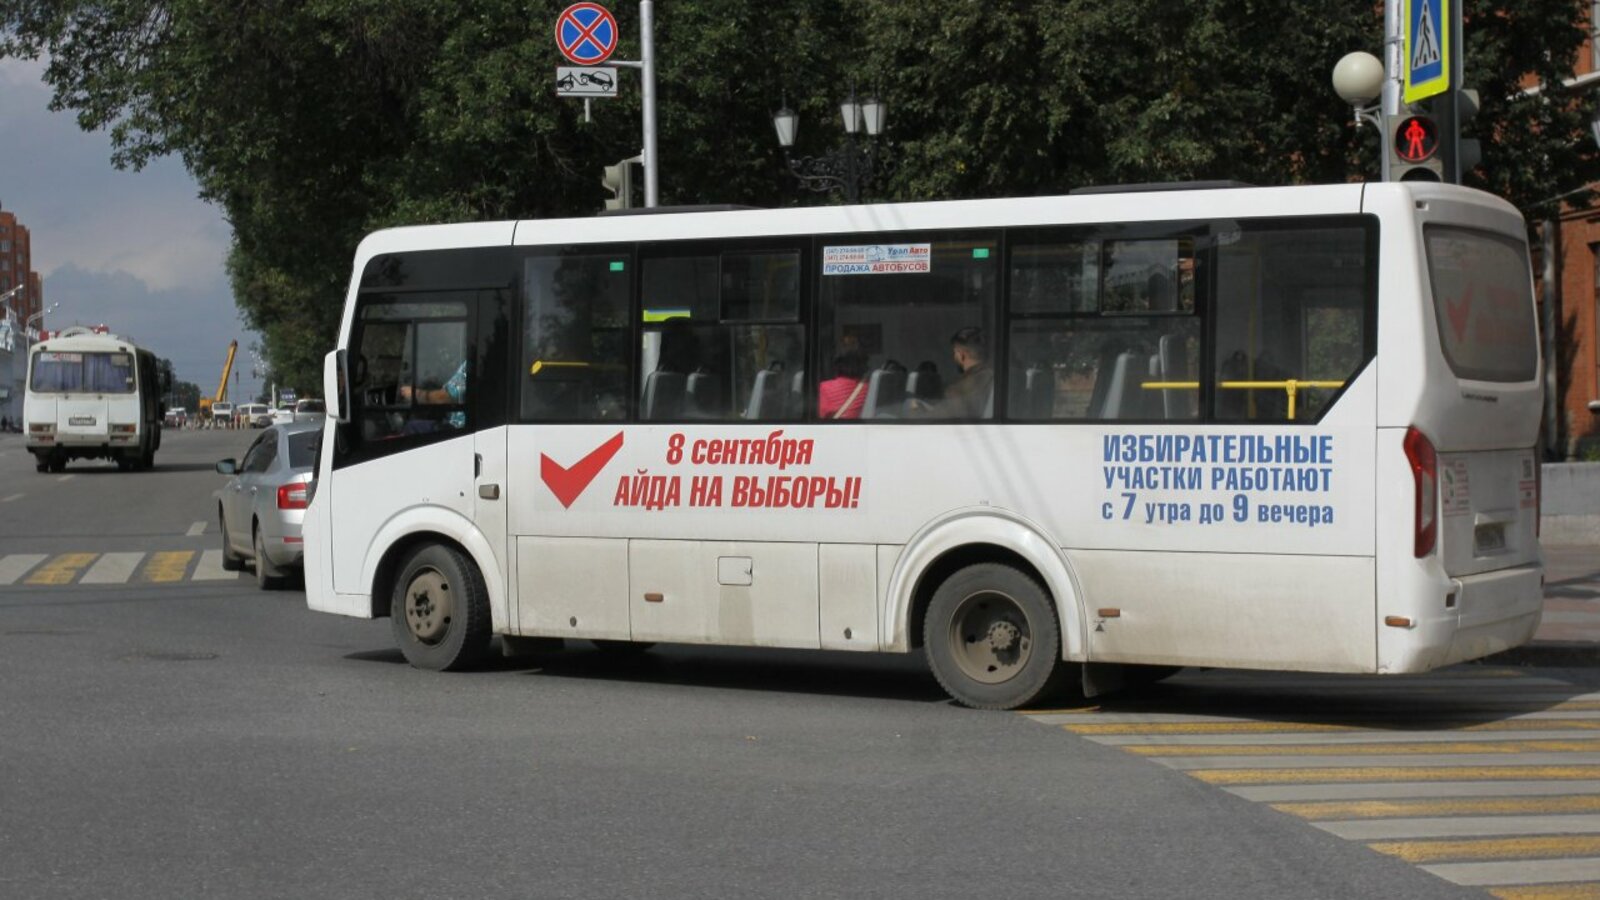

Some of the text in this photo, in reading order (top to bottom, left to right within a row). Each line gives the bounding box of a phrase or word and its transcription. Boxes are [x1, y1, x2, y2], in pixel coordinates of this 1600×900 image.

[888, 247, 928, 256] Урал Авто
[825, 262, 929, 273] ПРОДАЖА АВТОБУСОВ
[666, 430, 814, 470] 8 сентября
[1103, 434, 1333, 464] ИЗБИРАТЕЛЬНЫЕ
[613, 468, 862, 511] АЙДА НА ВЫБОРЫ!
[1103, 466, 1332, 492] УЧАСТКИ РАБОТАЮТ
[1102, 493, 1334, 527] с 7 утра до 9 вечера
